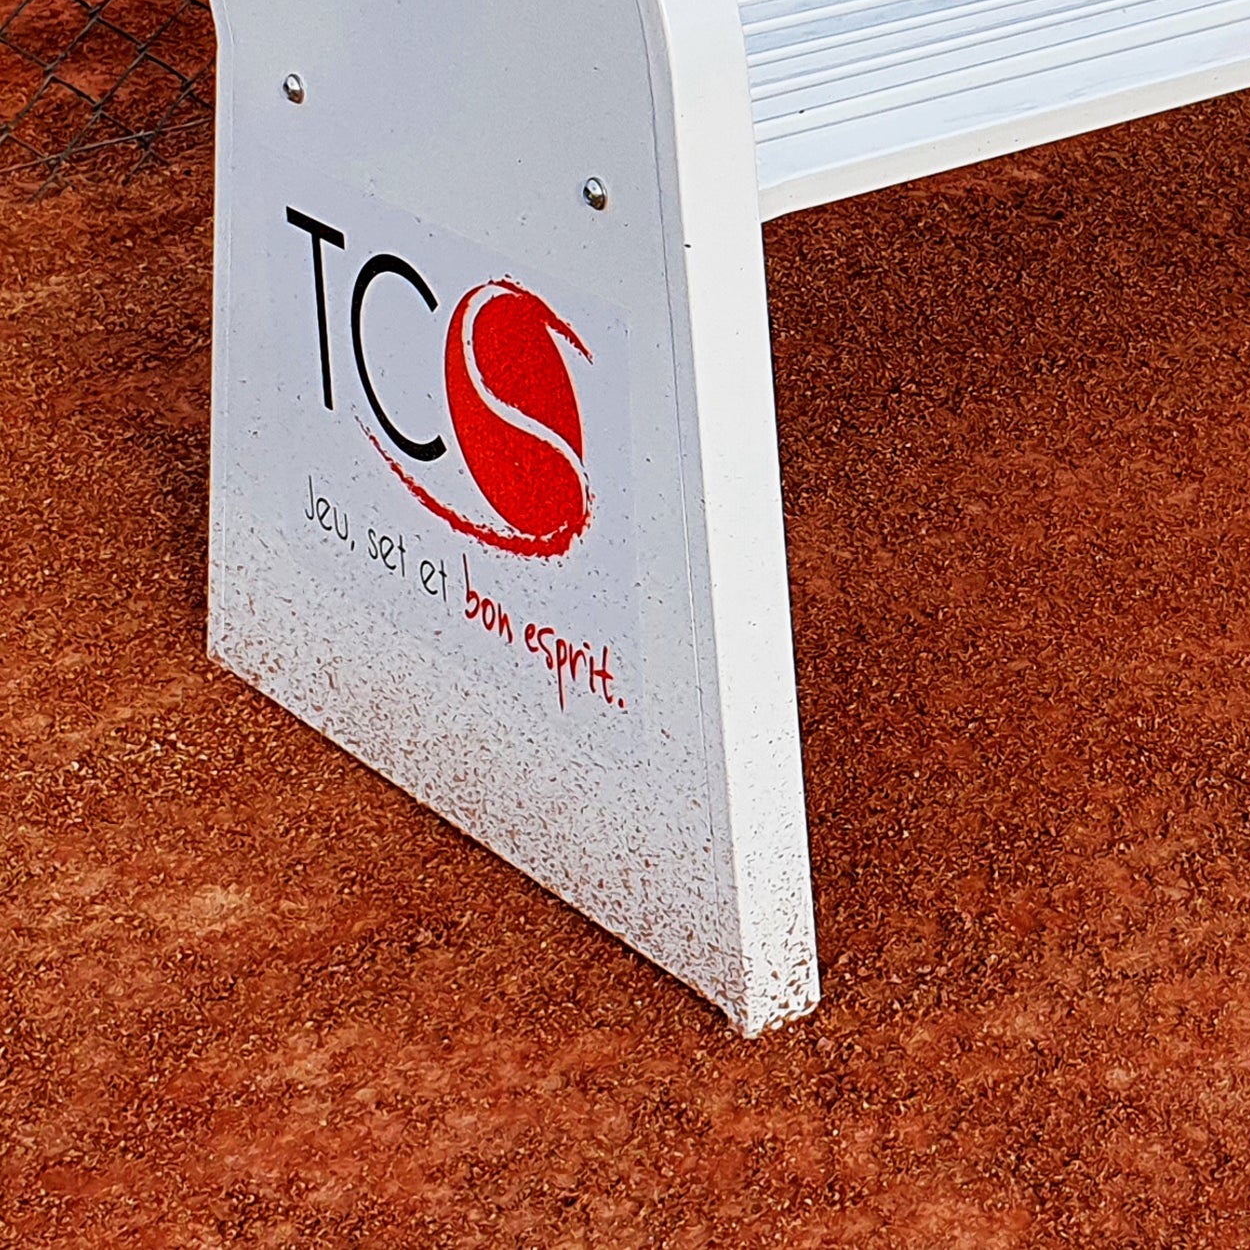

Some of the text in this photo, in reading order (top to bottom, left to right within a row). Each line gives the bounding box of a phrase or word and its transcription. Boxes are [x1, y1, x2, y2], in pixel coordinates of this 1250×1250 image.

[304, 475, 625, 713] Jeu, set et bon esprit.
